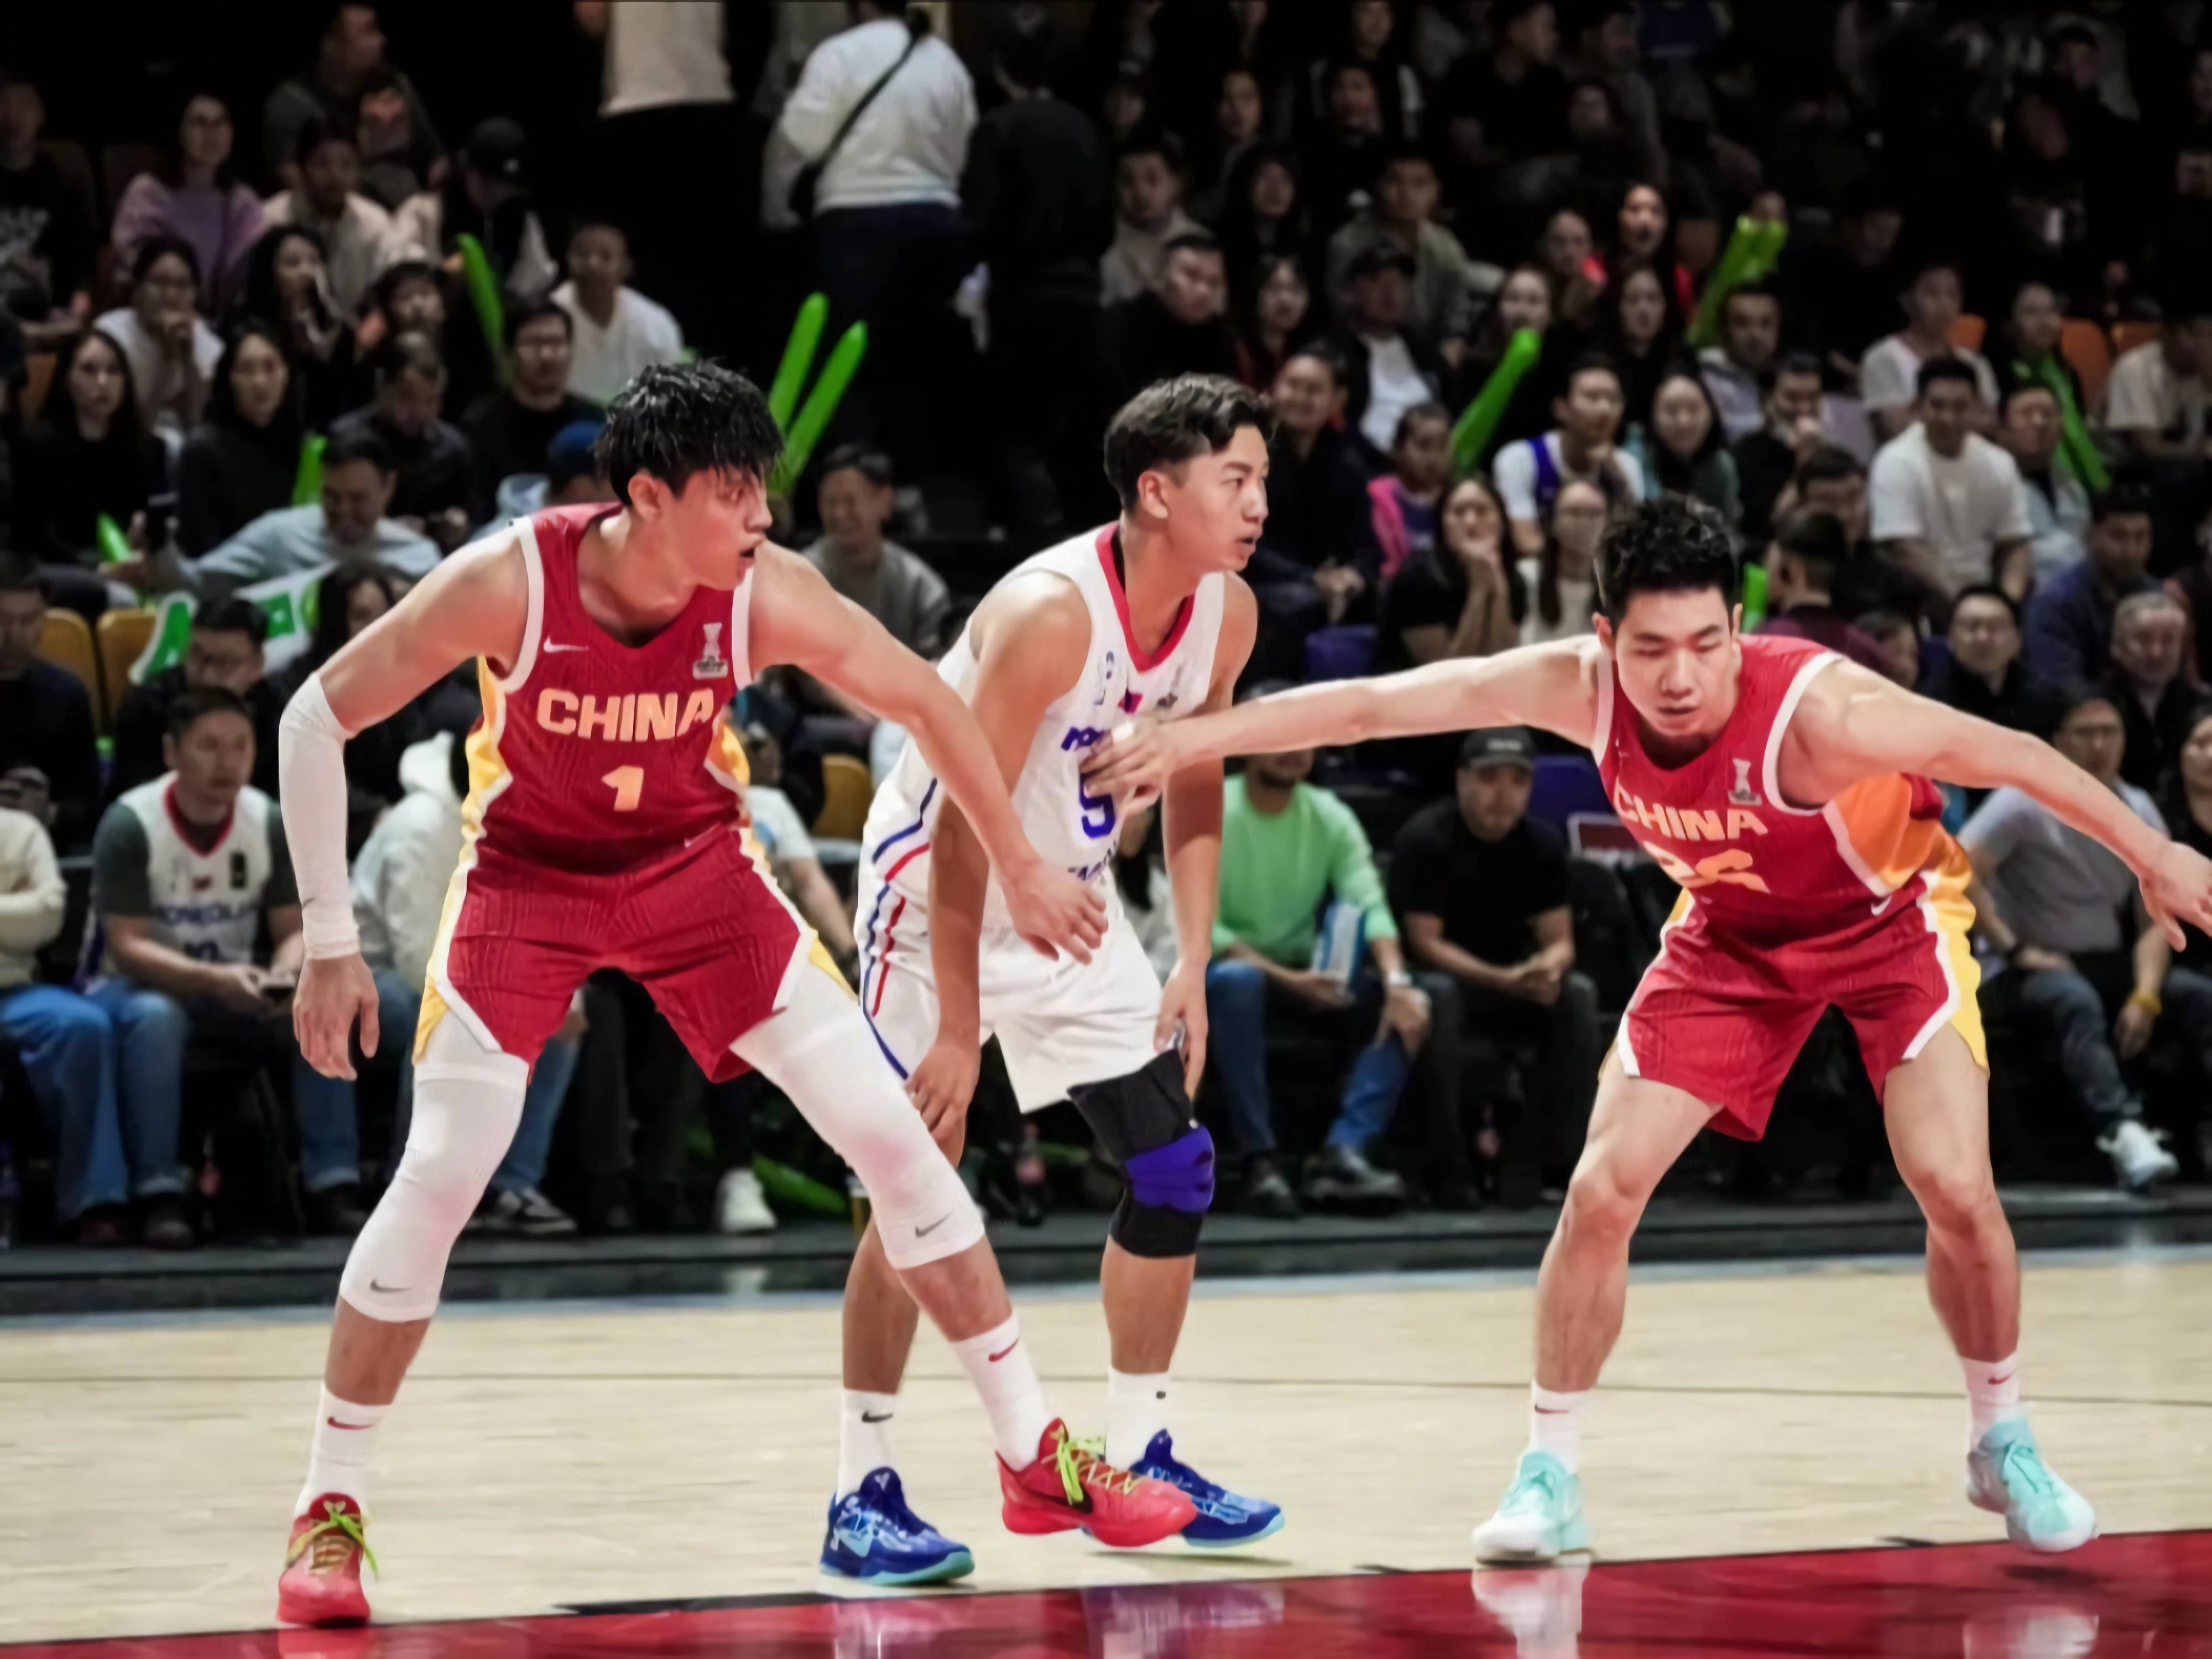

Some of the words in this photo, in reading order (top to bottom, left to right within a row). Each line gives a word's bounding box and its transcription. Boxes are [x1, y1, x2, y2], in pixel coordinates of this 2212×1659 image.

[536, 687, 714, 742] CHINA
[601, 764, 644, 812] 1
[1078, 769, 1117, 839] 5
[1613, 775, 1769, 841] CHINA
